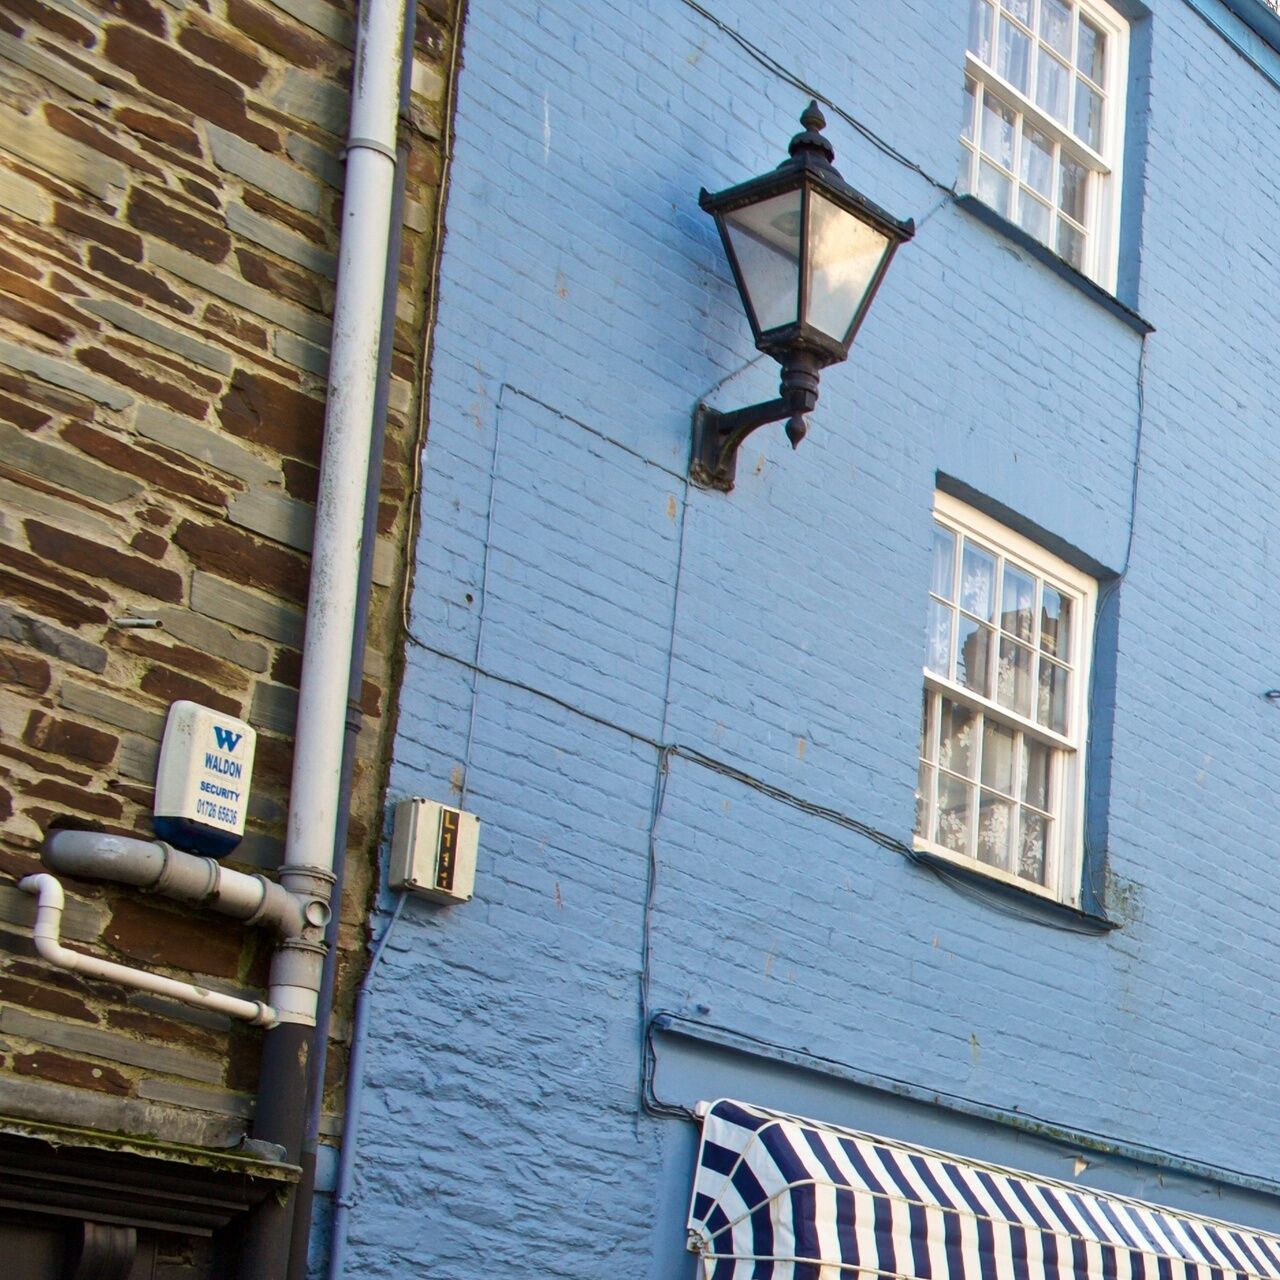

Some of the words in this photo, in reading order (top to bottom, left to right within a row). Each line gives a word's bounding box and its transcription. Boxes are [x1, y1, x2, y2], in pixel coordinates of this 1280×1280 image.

[213, 726, 242, 752] W
[204, 752, 242, 779] WALDON
[200, 781, 241, 801] SECURITY
